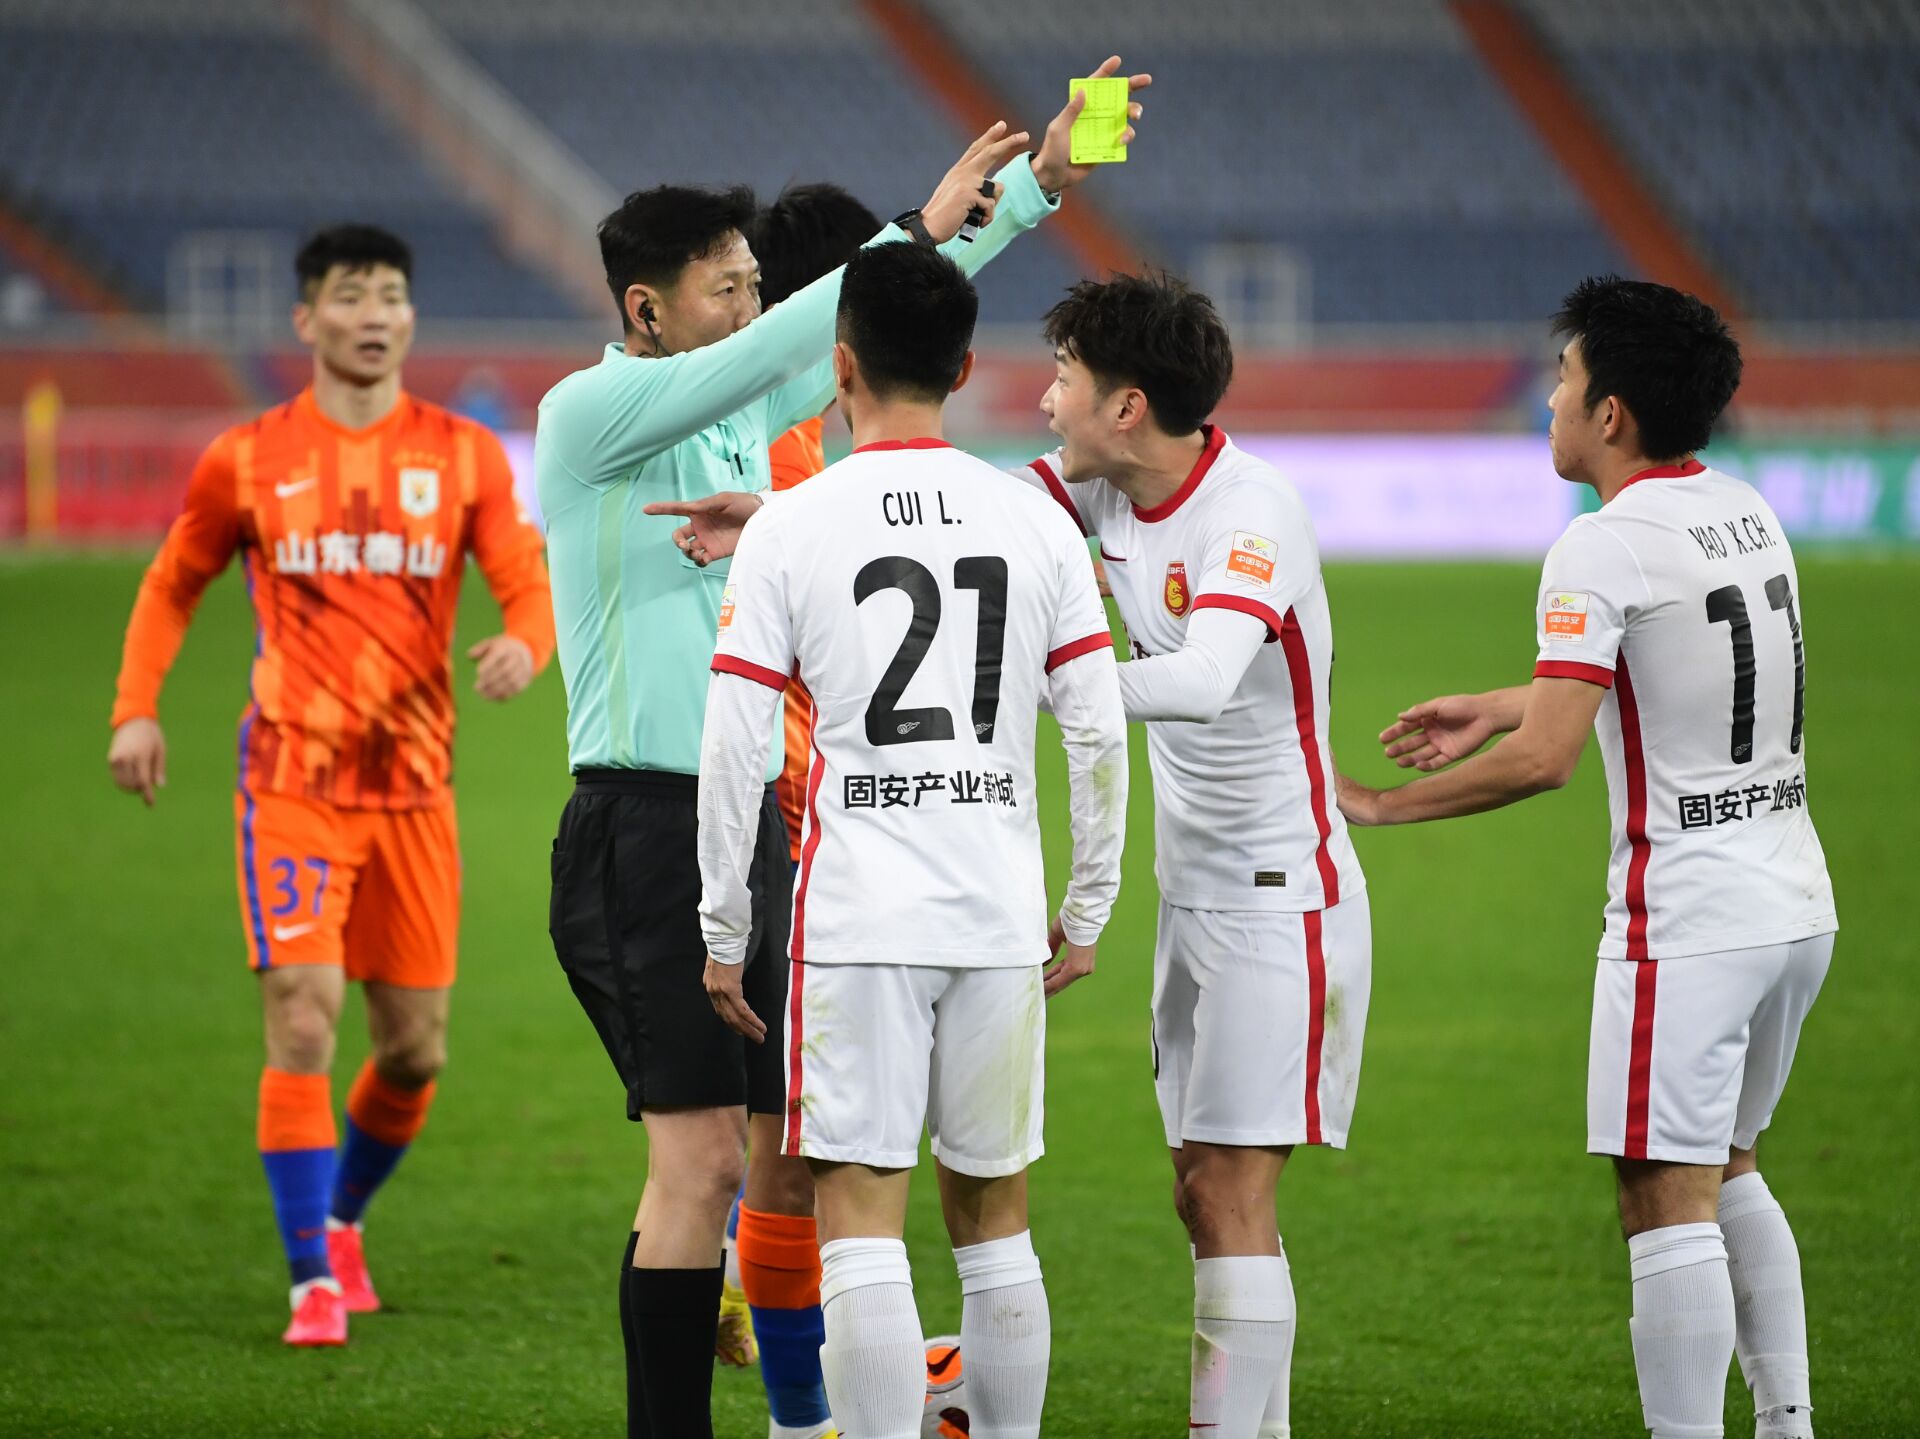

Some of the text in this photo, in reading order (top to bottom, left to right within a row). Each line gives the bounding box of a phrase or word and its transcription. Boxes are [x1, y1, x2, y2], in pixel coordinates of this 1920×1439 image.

[883, 490, 963, 526] CUI L.
[275, 530, 446, 577] 山东泰山
[1687, 512, 1777, 560] YAO X.CH.
[853, 555, 1008, 746] 21
[1706, 573, 1805, 765] 11
[844, 770, 1016, 810] 固安产业新城
[270, 856, 329, 916] 37
